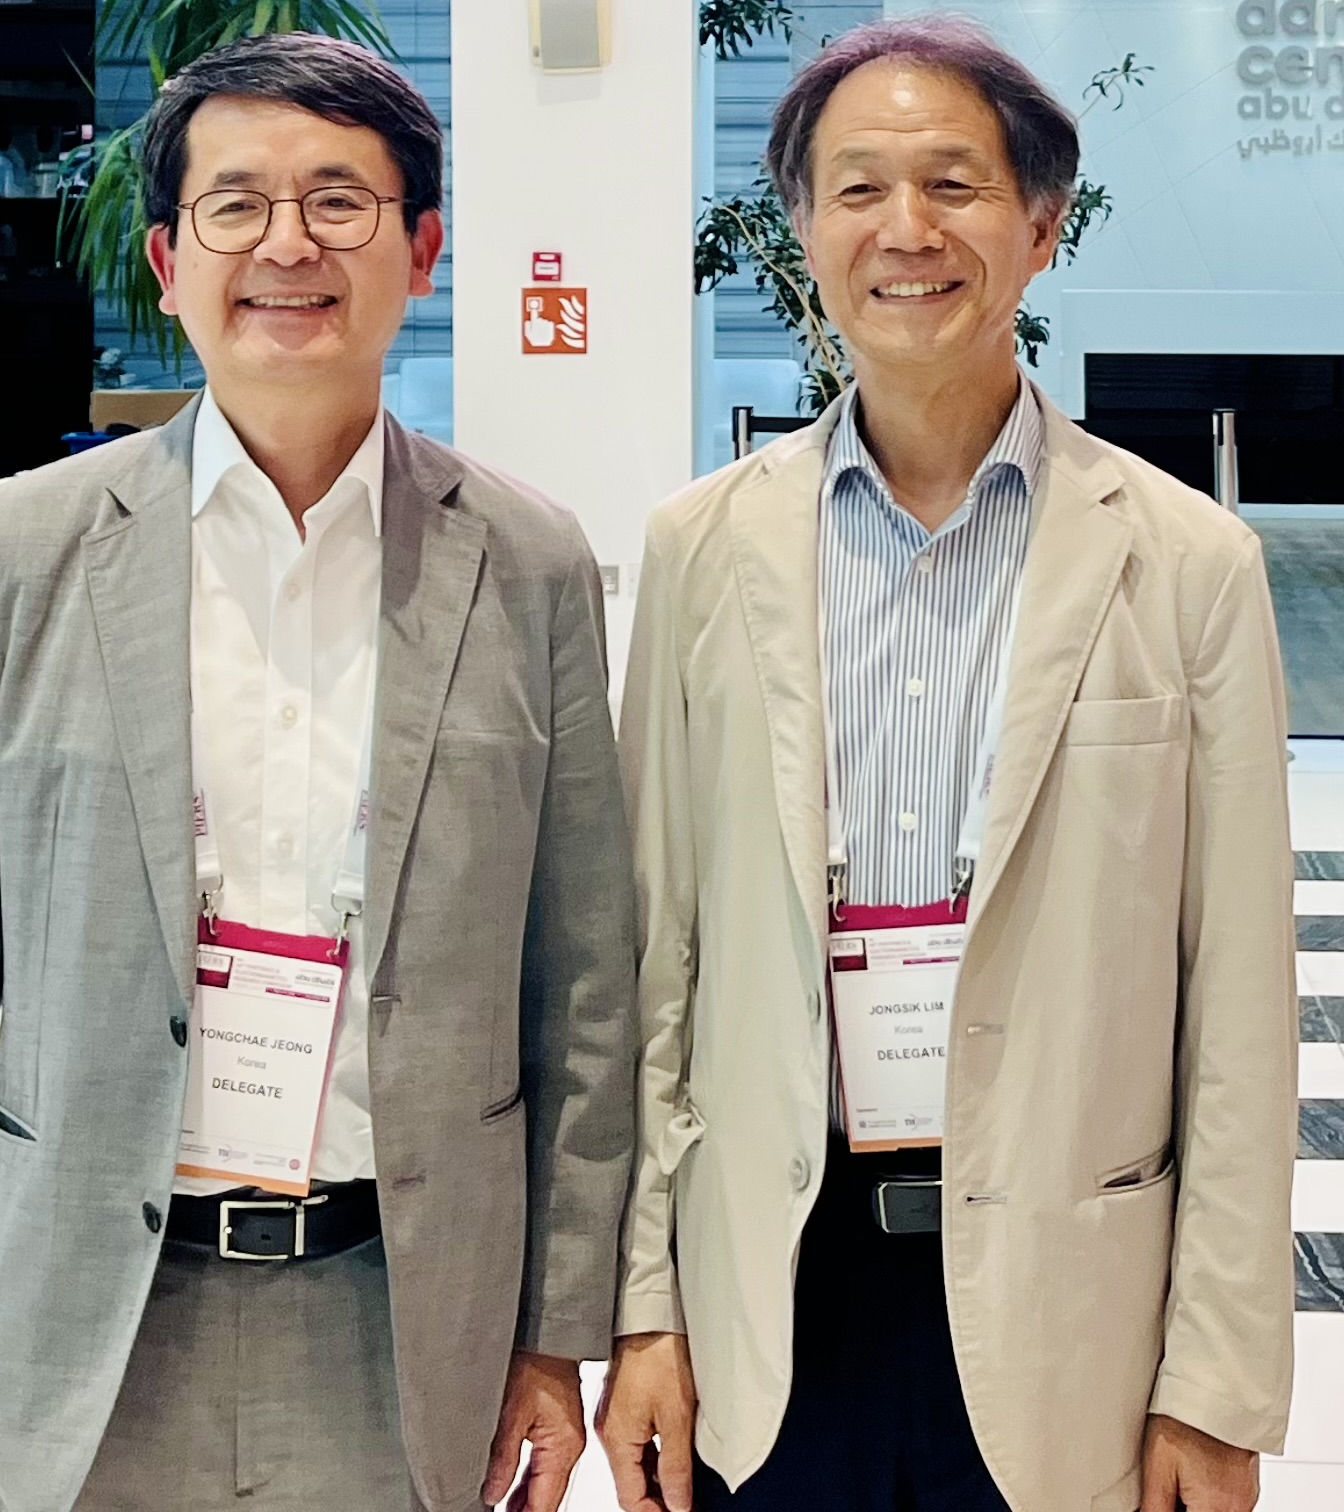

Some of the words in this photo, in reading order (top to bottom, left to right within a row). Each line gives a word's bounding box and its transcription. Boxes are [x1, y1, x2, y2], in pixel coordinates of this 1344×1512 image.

[1237, 88, 1312, 120] abu
[199, 1027, 269, 1048] YONGCHAE
[270, 1039, 313, 1055] JEONG
[877, 1045, 945, 1061] DELEGATE
[212, 1077, 284, 1100] DELEGATE
